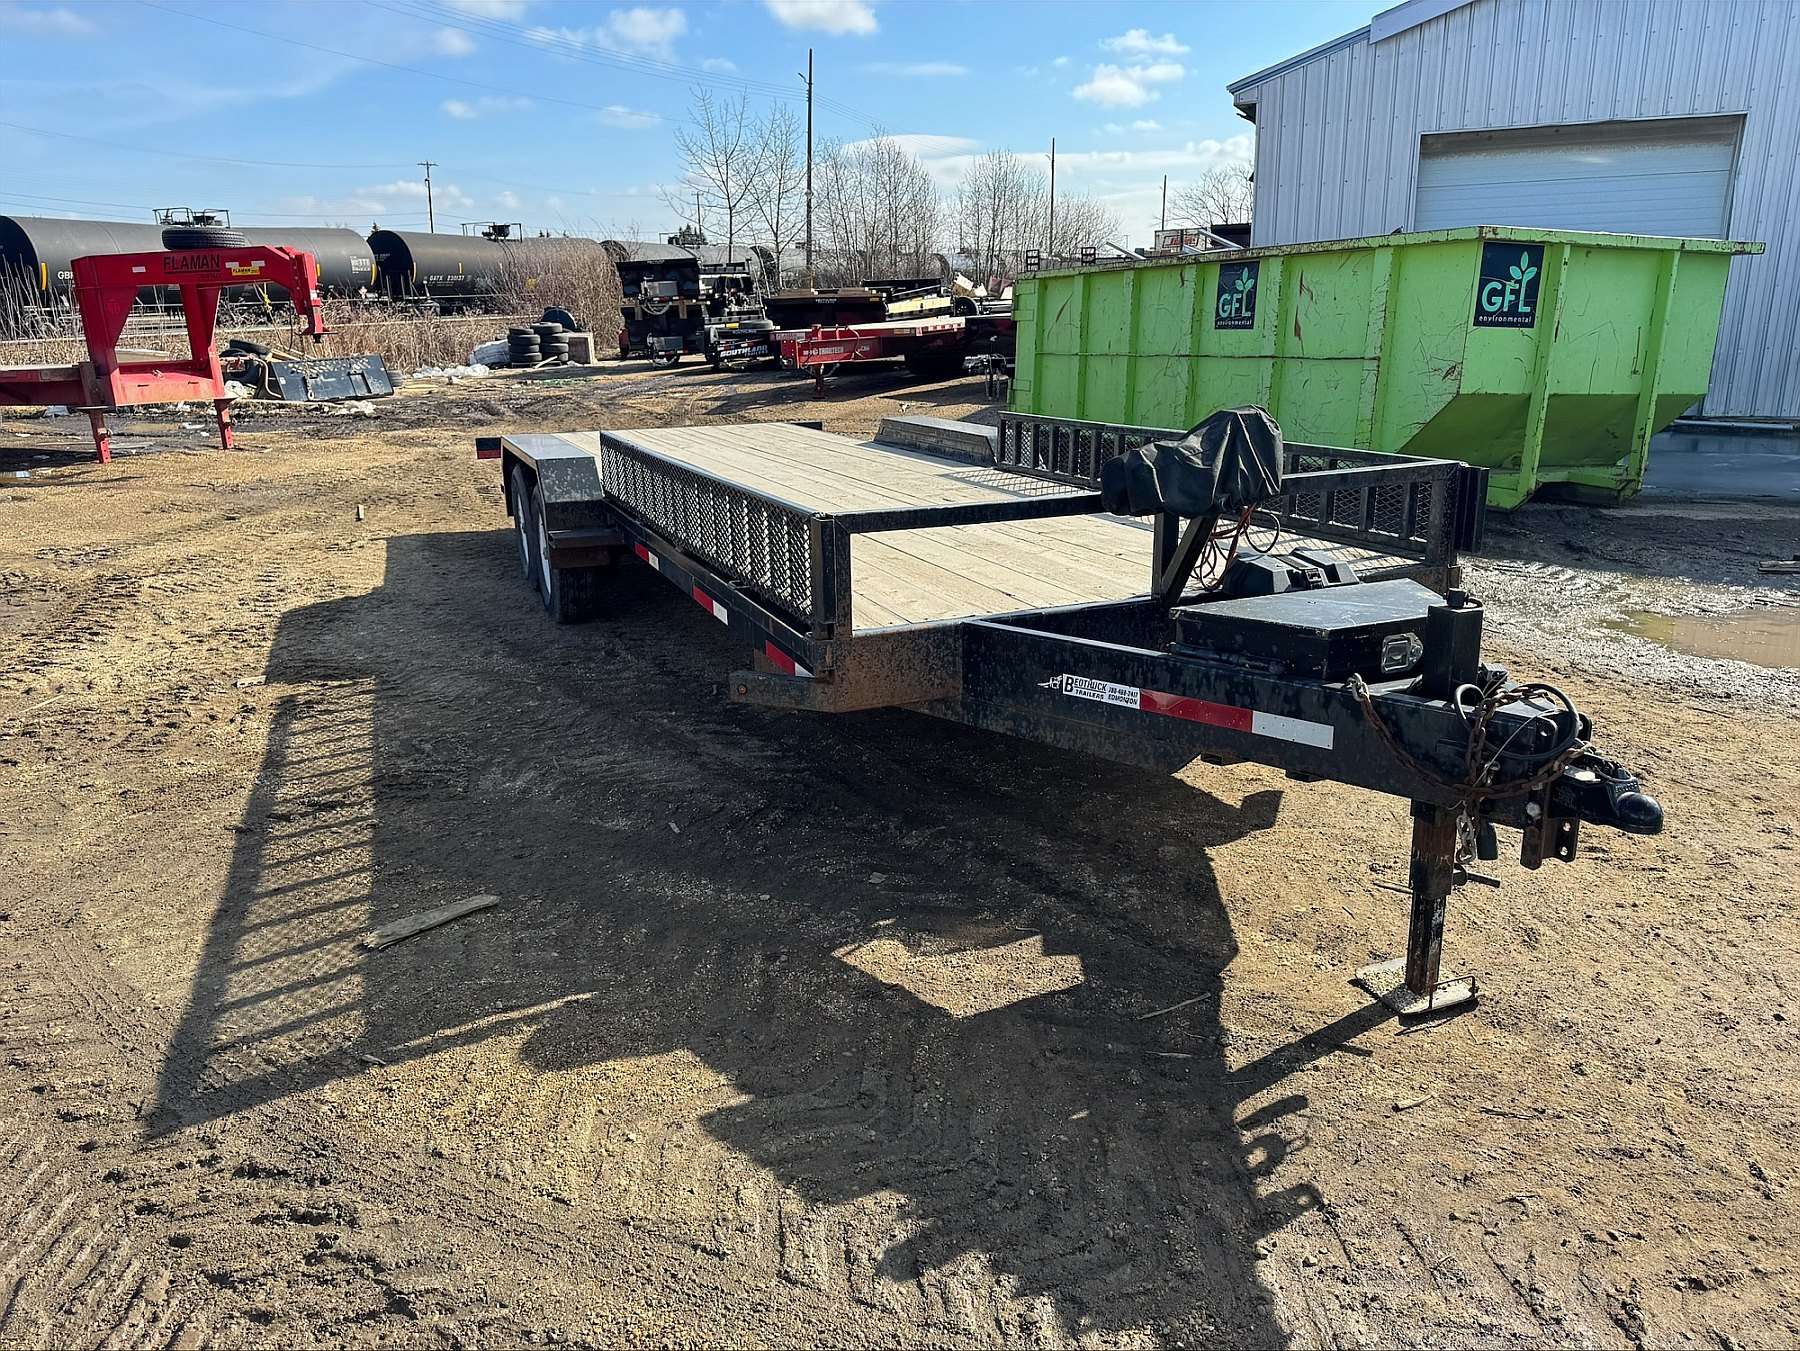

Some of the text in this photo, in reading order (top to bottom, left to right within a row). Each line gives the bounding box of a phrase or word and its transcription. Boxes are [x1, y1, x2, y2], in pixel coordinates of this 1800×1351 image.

[163, 255, 220, 271] FLAMAN
[1481, 276, 1531, 312] GFL
[1218, 288, 1252, 318] GFL
[1478, 315, 1532, 323] environmental
[720, 345, 768, 357] SOUTHLAND
[1075, 689, 1104, 700] TRAILERS
